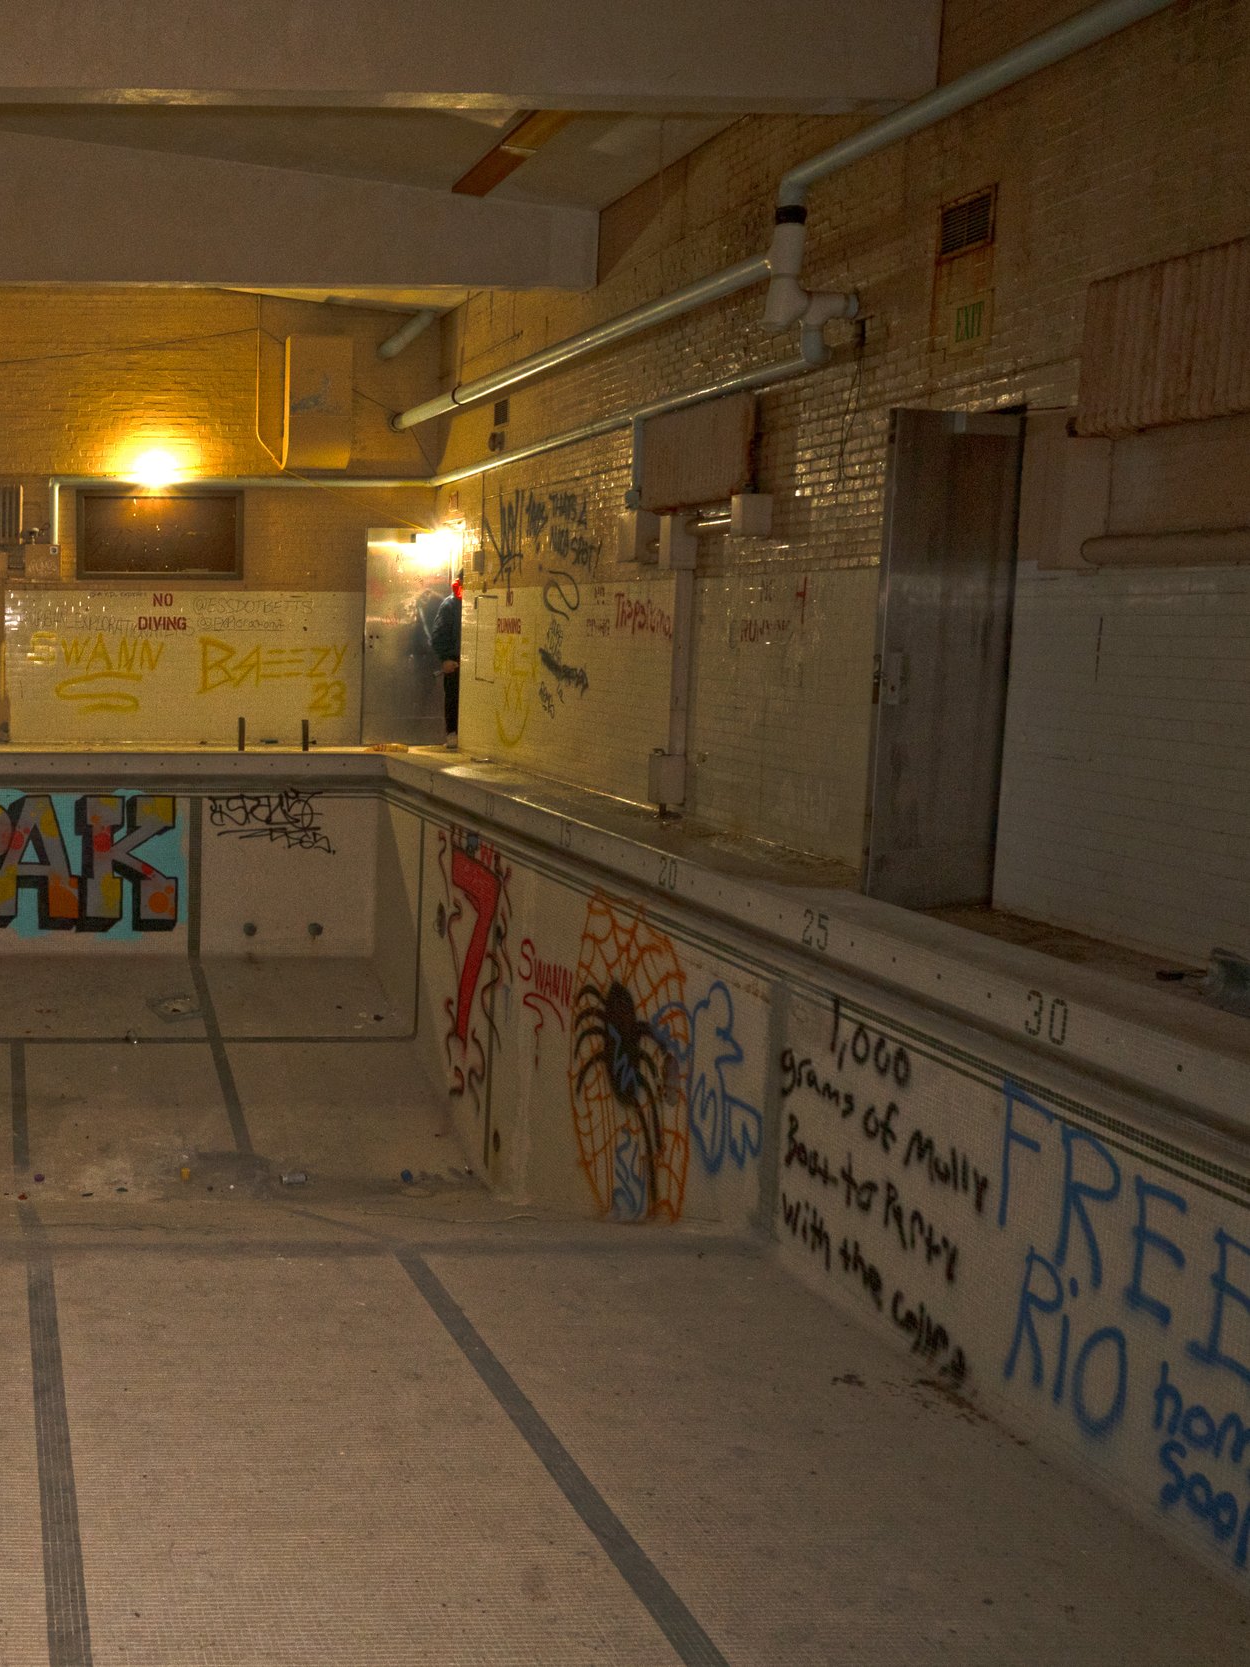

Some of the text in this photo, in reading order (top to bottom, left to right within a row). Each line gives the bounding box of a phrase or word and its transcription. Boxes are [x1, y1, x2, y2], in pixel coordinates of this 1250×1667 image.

[955, 300, 985, 343] EXIT
[152, 592, 174, 608] NO
[138, 616, 187, 631] DIVING
[497, 617, 522, 635] RUNNING
[308, 680, 347, 719] 23
[559, 818, 572, 848] 15
[658, 856, 678, 891] 20
[802, 908, 830, 951] 25
[1024, 989, 1069, 1047] 30
[781, 1048, 855, 1118] grams
[862, 1102, 899, 1153] of
[999, 1072, 1250, 1388] FREE
